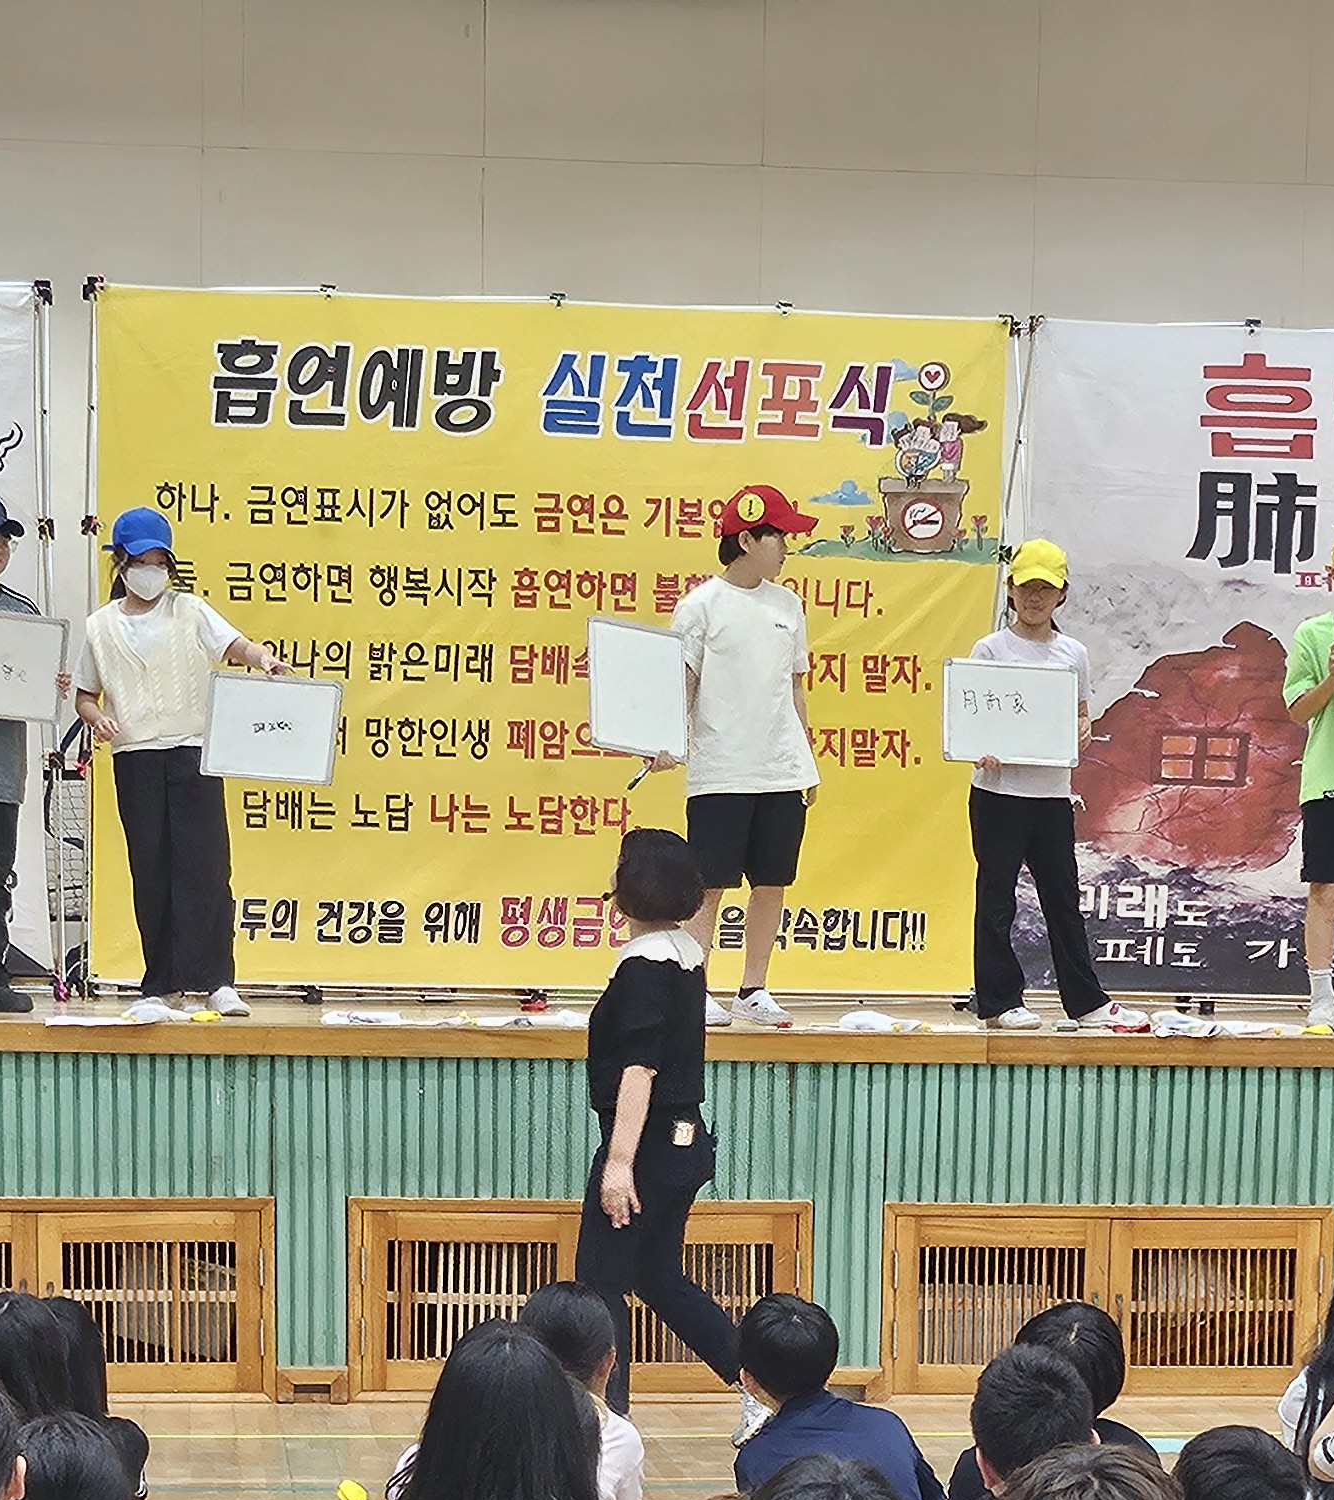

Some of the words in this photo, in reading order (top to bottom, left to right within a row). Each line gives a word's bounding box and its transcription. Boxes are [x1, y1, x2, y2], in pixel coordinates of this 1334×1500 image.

[212, 337, 501, 433] 흡연예방
[543, 353, 895, 446] 실천선포식
[155, 481, 230, 523] 하나.
[246, 485, 410, 528] 금연표시가
[425, 490, 518, 531] 없어도
[533, 493, 629, 535] 금연은
[226, 562, 353, 604] 금연하면
[369, 564, 497, 607] 행복시작
[511, 569, 638, 612] 흡연하면
[368, 642, 493, 685] 밝은미래
[863, 654, 934, 694] 말자.
[365, 717, 491, 759] 망한인생
[244, 790, 336, 831] 담배는
[430, 795, 491, 834] 나는
[316, 899, 406, 945] 건강을
[423, 901, 483, 945] 위해
[1096, 936, 1203, 968] 폐도
